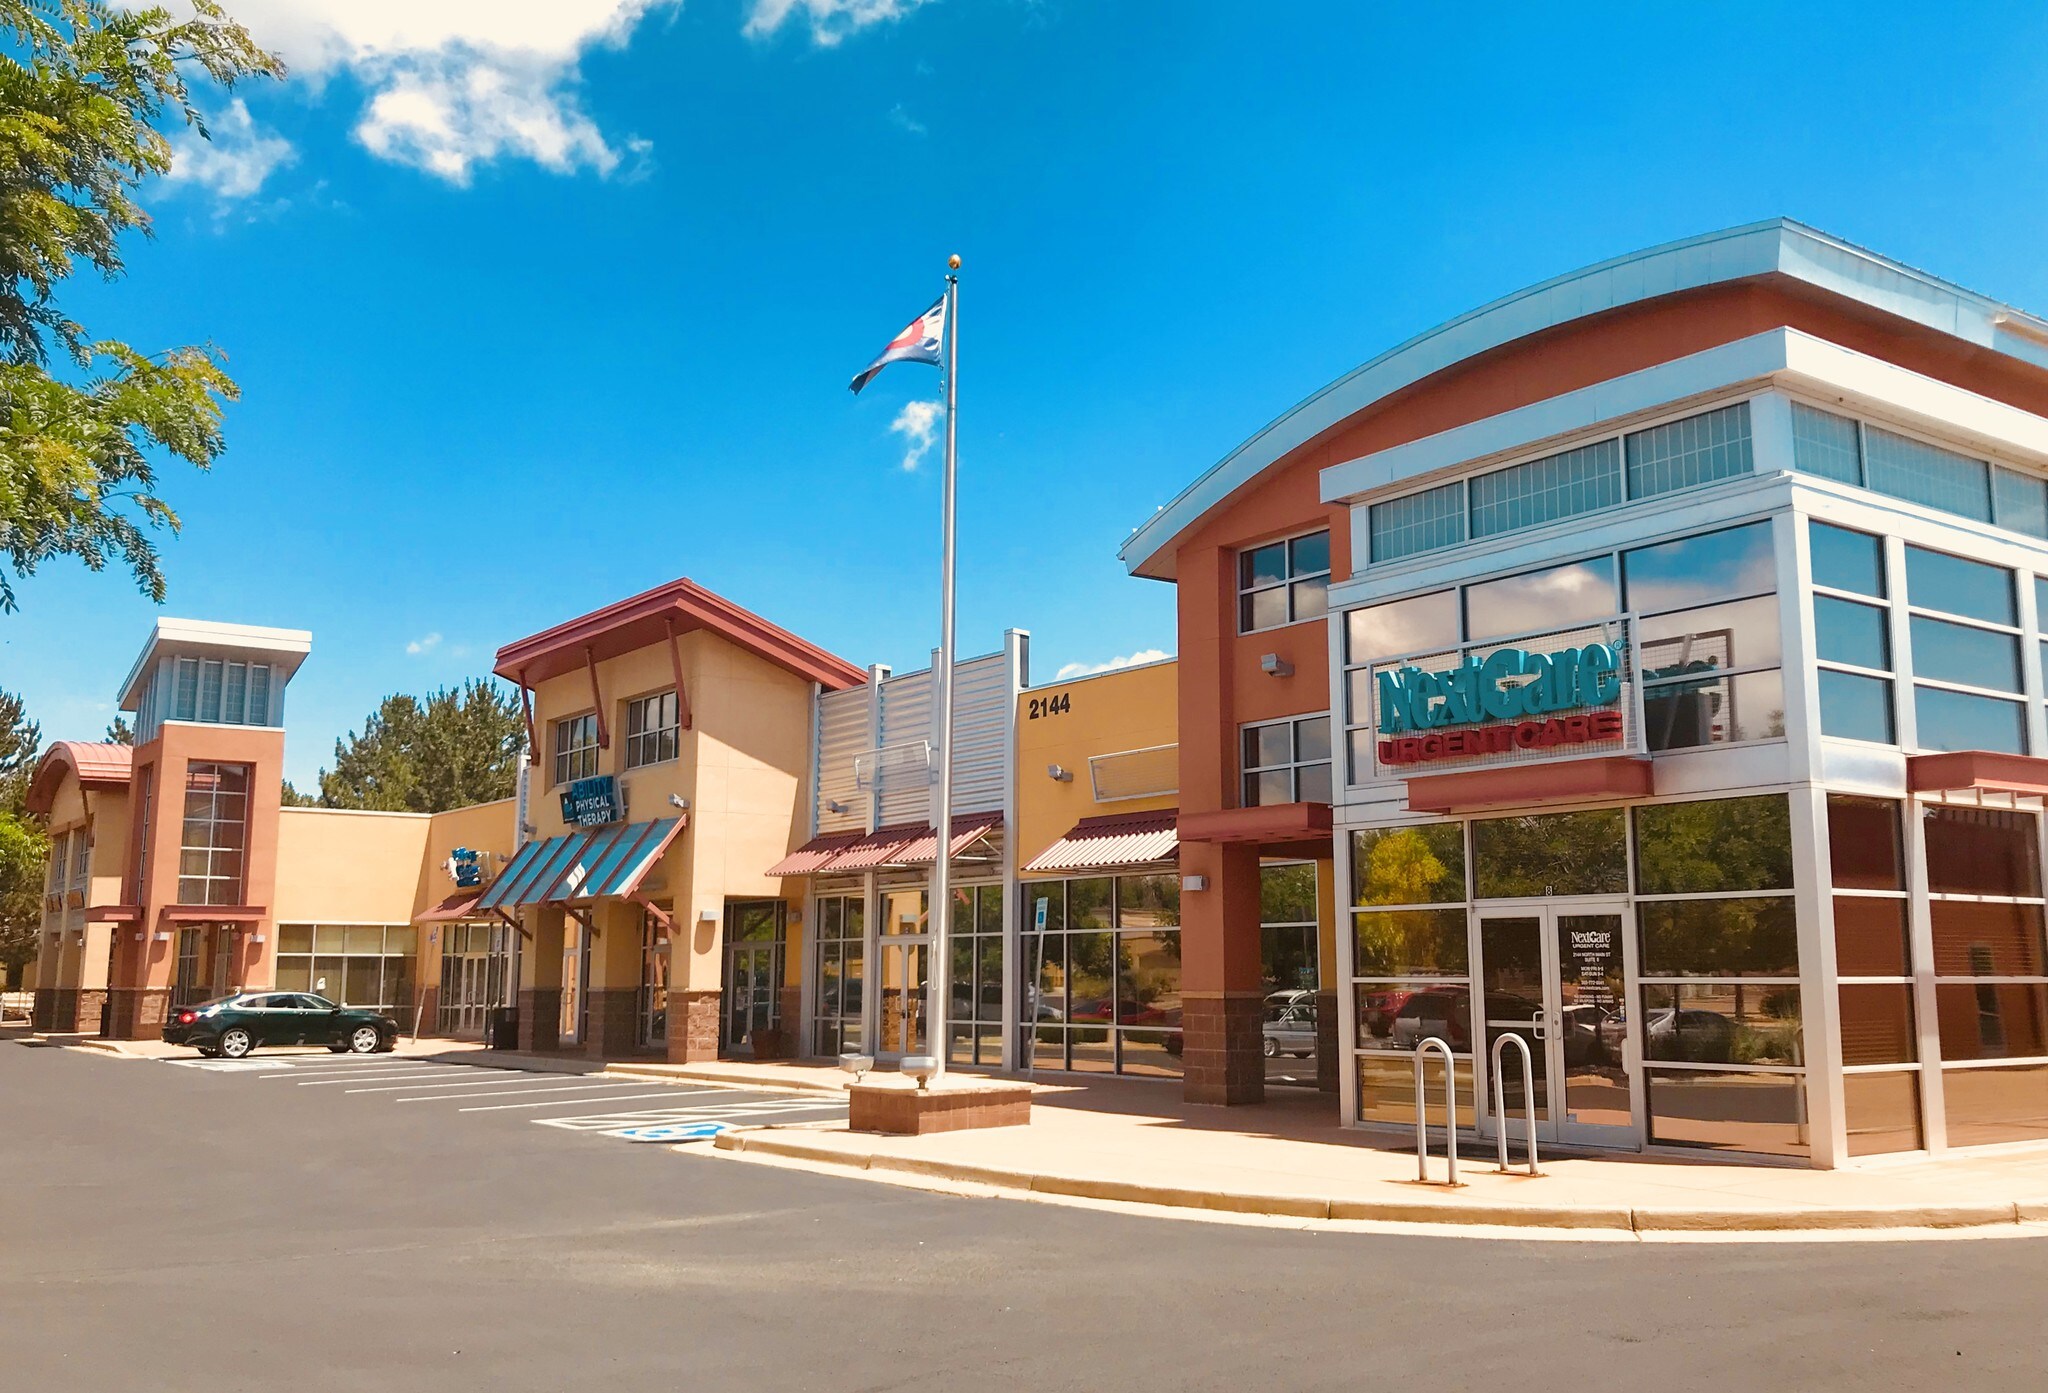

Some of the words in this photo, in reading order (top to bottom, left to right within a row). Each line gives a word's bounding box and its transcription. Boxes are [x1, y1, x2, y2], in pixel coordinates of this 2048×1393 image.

[1029, 692, 1071, 720] 2144
[1378, 724, 1516, 766] URGENT
[1514, 710, 1623, 750] CARE
[571, 775, 608, 801] ABILITY
[575, 795, 610, 813] PHYSICAL
[577, 809, 611, 827] THERAPY
